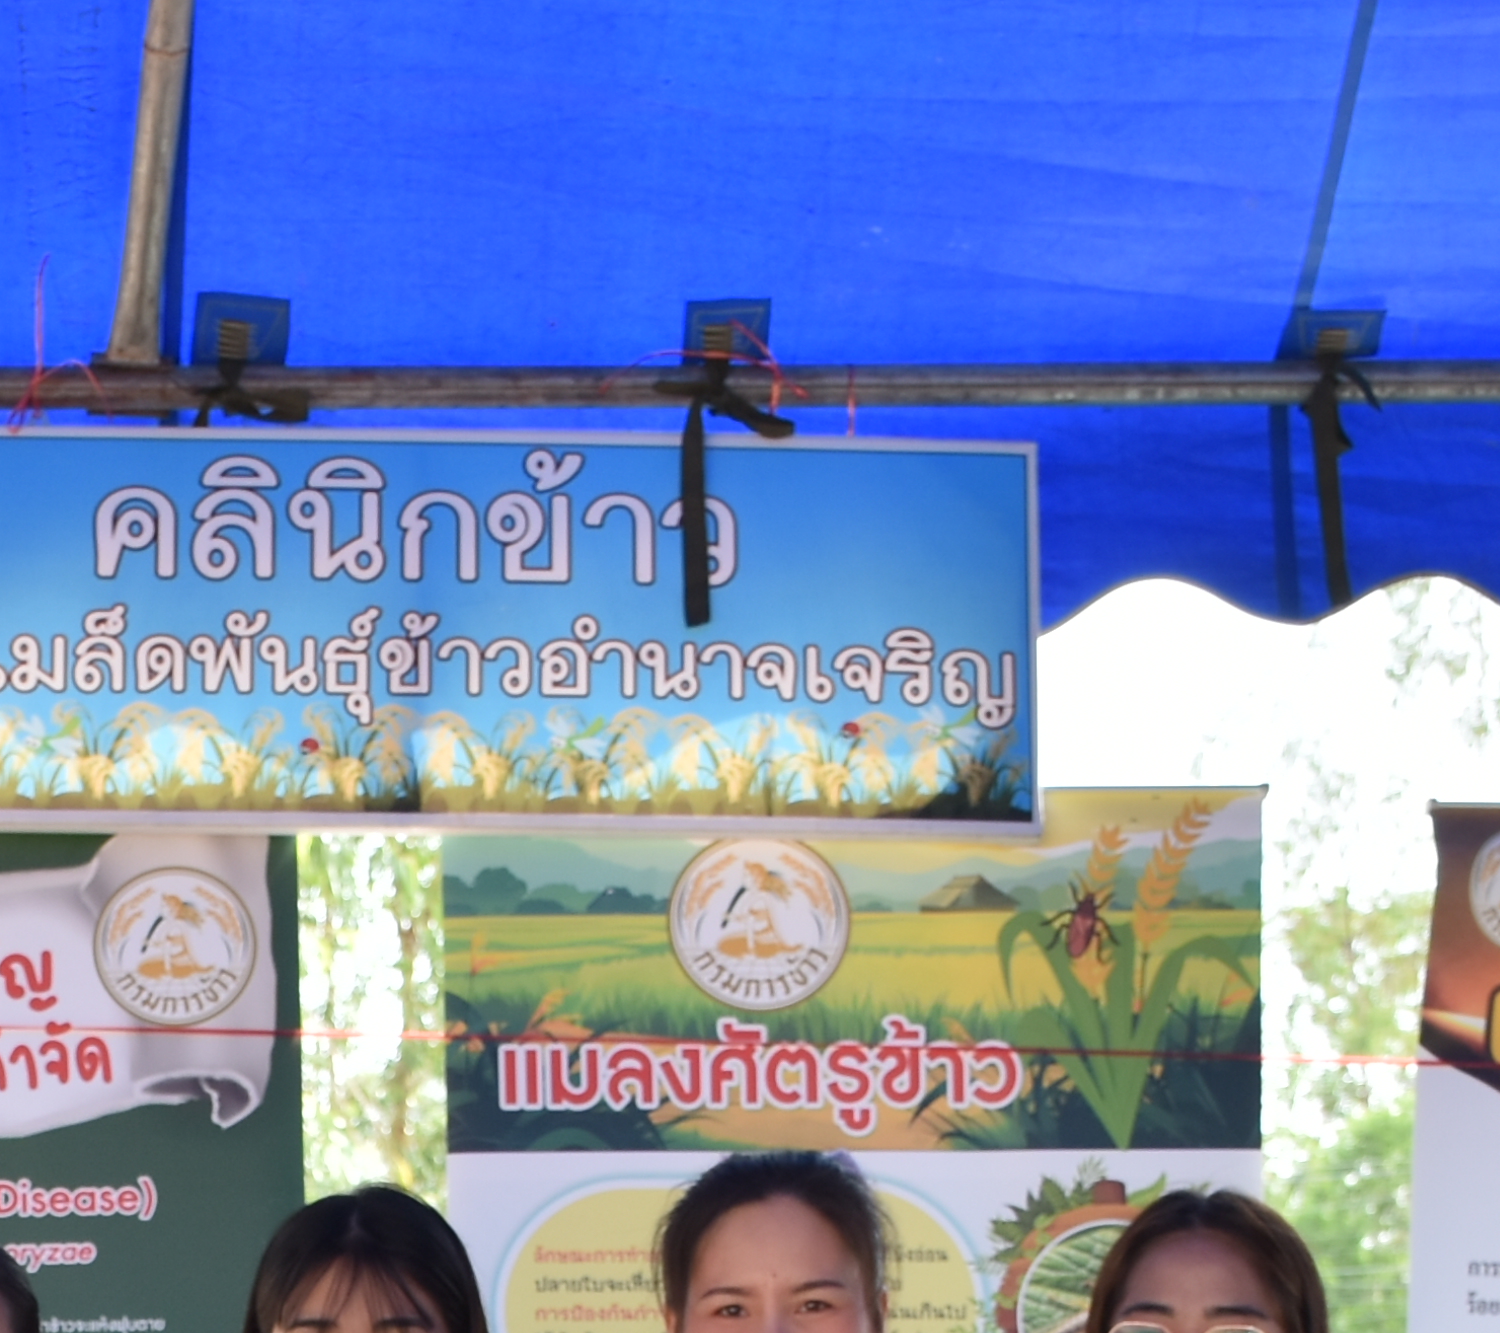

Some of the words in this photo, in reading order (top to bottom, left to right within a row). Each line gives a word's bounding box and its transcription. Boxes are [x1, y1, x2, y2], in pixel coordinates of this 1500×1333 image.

[94, 449, 740, 588] คลินิกข้าว
[498, 1015, 1022, 1135] แมลงศัตรูข้าว
